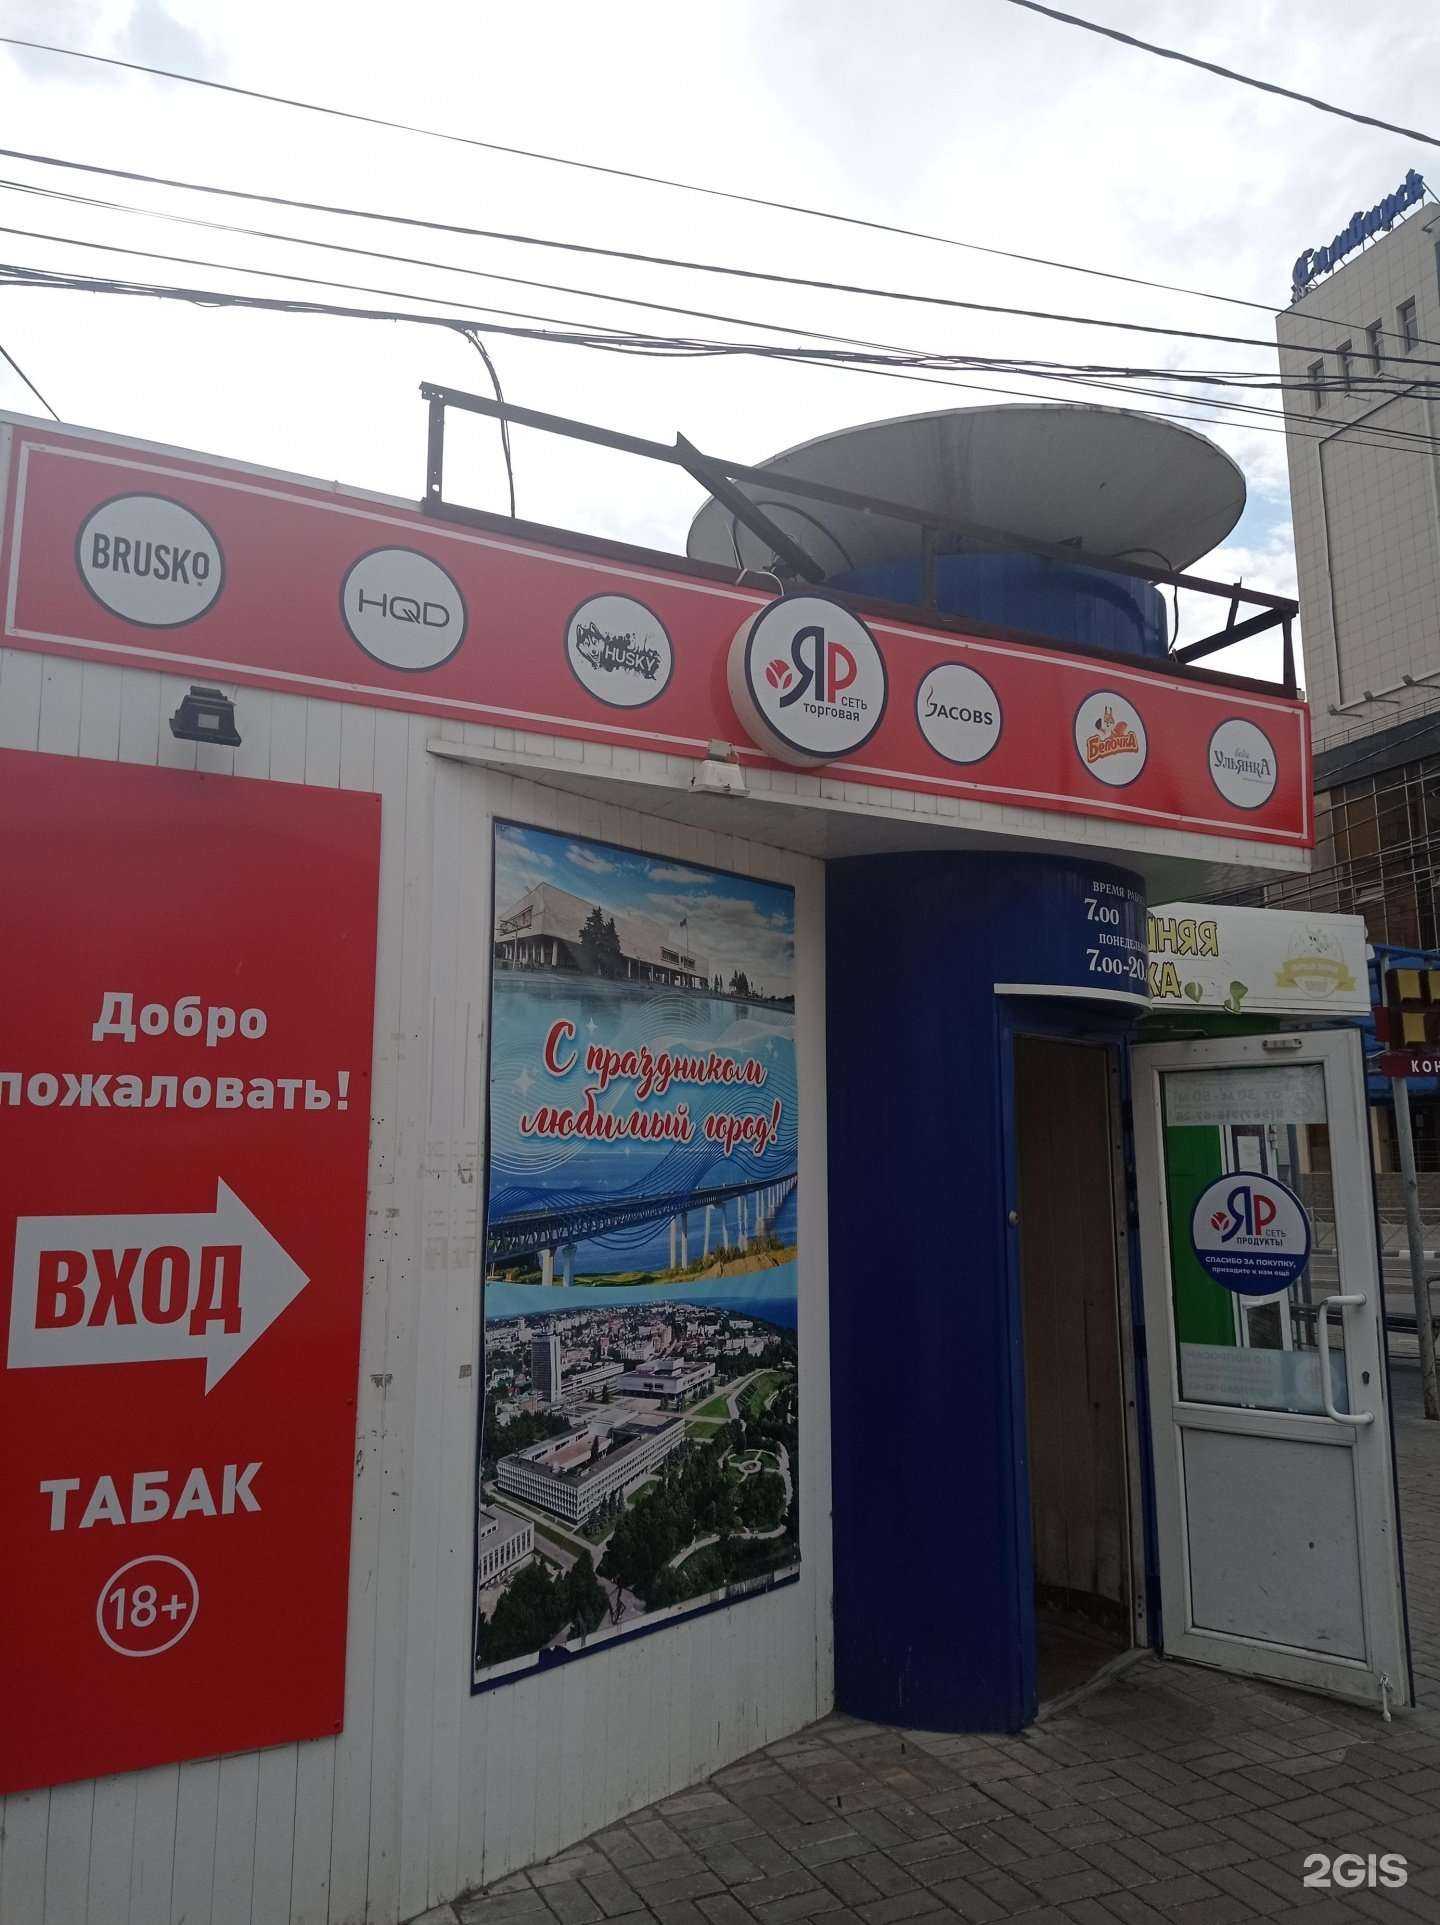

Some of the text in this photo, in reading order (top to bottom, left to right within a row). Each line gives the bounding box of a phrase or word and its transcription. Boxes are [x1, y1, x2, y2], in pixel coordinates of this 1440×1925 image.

[92, 533, 210, 586] BRUSKO
[358, 588, 450, 628] HQD
[605, 645, 656, 671] HUSKY
[779, 625, 857, 708] ЯР
[803, 702, 860, 722] торговая
[841, 696, 868, 710] СЕТЬ
[925, 702, 993, 725] JACOBS
[1084, 898, 1120, 925] 7.00
[1093, 881, 1145, 904] ВРЕМЯ РАБ
[92, 992, 268, 1047] Добро
[543, 1019, 767, 1100] С праздником
[0, 1070, 351, 1113] пожаловать!
[520, 1087, 782, 1156] любимый город!
[1221, 1185, 1277, 1242] ЯР
[1265, 1229, 1287, 1238] СЕТЬ
[1205, 1256, 1297, 1268] СПАСИБО ЗА ПОКУПКУ,
[1236, 1237, 1283, 1247] ПРОДУКТЫ
[33, 1245, 244, 1336] ВХОД
[39, 1462, 263, 1531] ТАБАК
[108, 1586, 188, 1630] 18+
